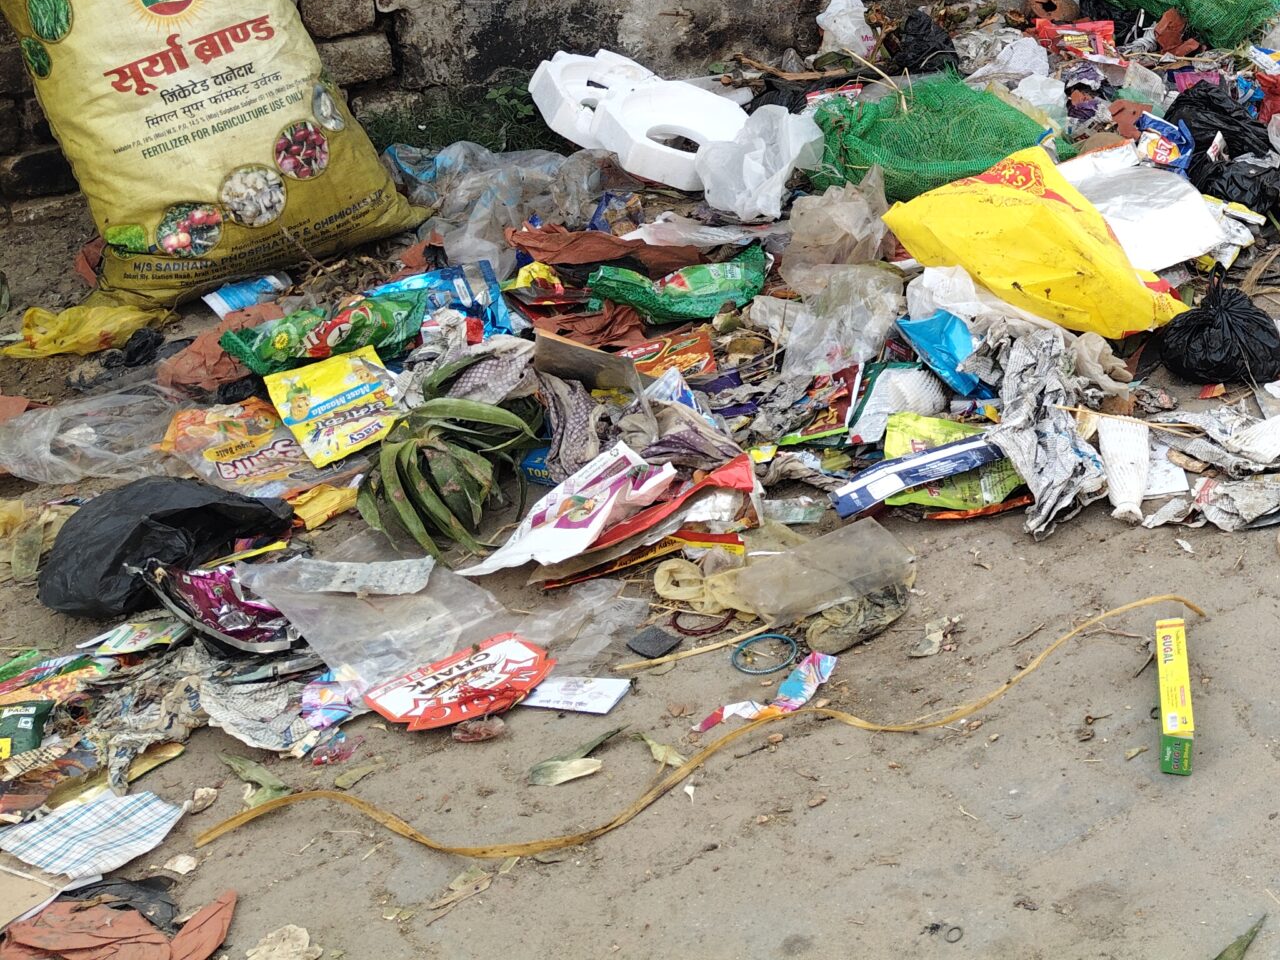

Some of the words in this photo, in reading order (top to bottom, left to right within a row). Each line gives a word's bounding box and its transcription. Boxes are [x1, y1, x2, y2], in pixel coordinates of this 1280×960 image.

[103, 33, 190, 97] सूर्या
[188, 14, 275, 65] ब्राण्ड
[160, 77, 210, 106] जिंकेटेड
[211, 61, 256, 88] दानेदार
[145, 109, 179, 129] सिंगल
[181, 101, 207, 121] सुपर
[209, 82, 249, 106] फॉस्फेट
[251, 71, 283, 91] उर्वरक
[142, 134, 191, 160] FERTILIZER
[191, 127, 210, 145] FOR
[211, 104, 270, 137] AGRICULTURE
[269, 97, 286, 114] USE
[286, 89, 306, 108] ONLY
[133, 261, 153, 273] M/S
[155, 260, 218, 272] SADHANA
[311, 395, 347, 416] Masala
[345, 384, 370, 400] Mast
[235, 440, 256, 453] Sugar
[349, 422, 384, 443] Lacy
[215, 447, 236, 458] Balls
[1161, 634, 1174, 665] GUGAL
[403, 652, 491, 693] CHALK
[431, 669, 539, 721] MGIC
